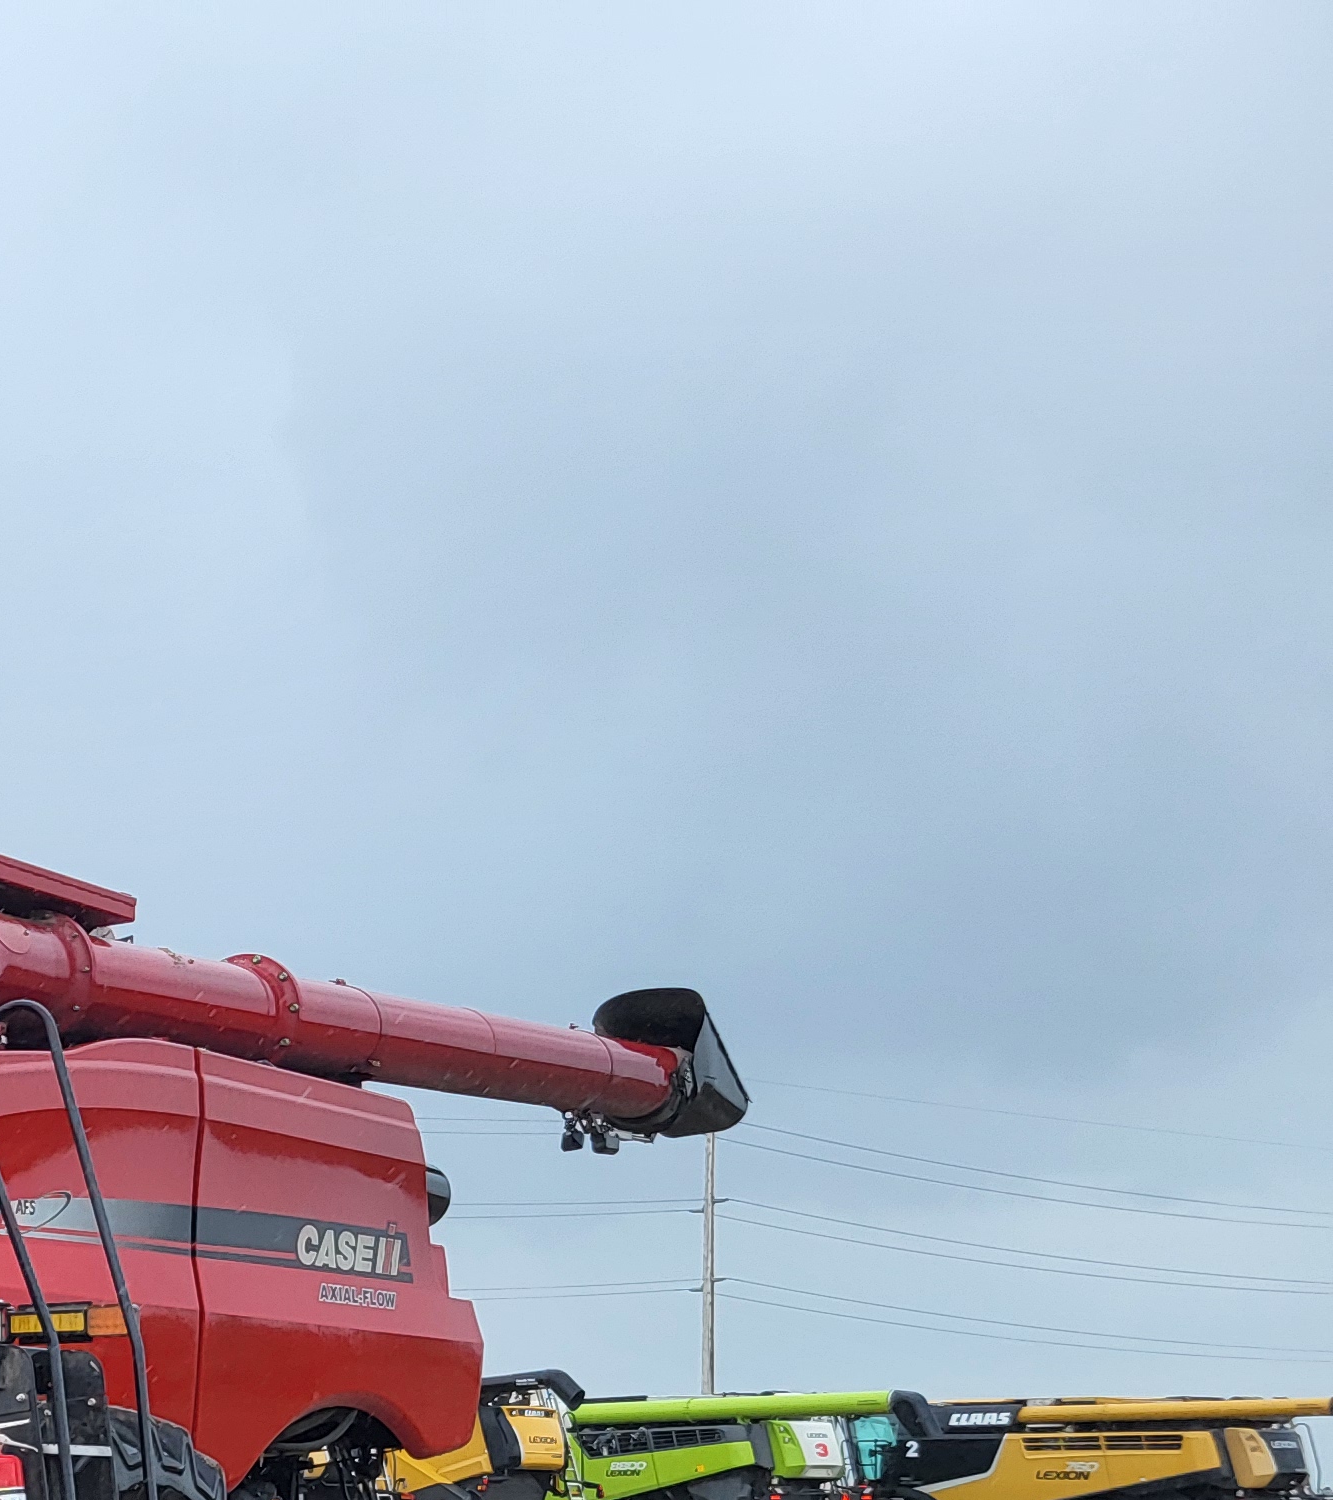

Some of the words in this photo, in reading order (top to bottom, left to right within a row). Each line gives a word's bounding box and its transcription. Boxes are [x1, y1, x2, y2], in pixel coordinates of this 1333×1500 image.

[16, 1201, 36, 1215] AFS
[297, 1225, 375, 1272] CASE
[319, 1283, 396, 1310] AXIAL-FLOW
[949, 1412, 1011, 1426] CLAAS
[814, 1443, 829, 1457] 3
[906, 1440, 919, 1458] 2
[1035, 1470, 1090, 1480] LEXION
